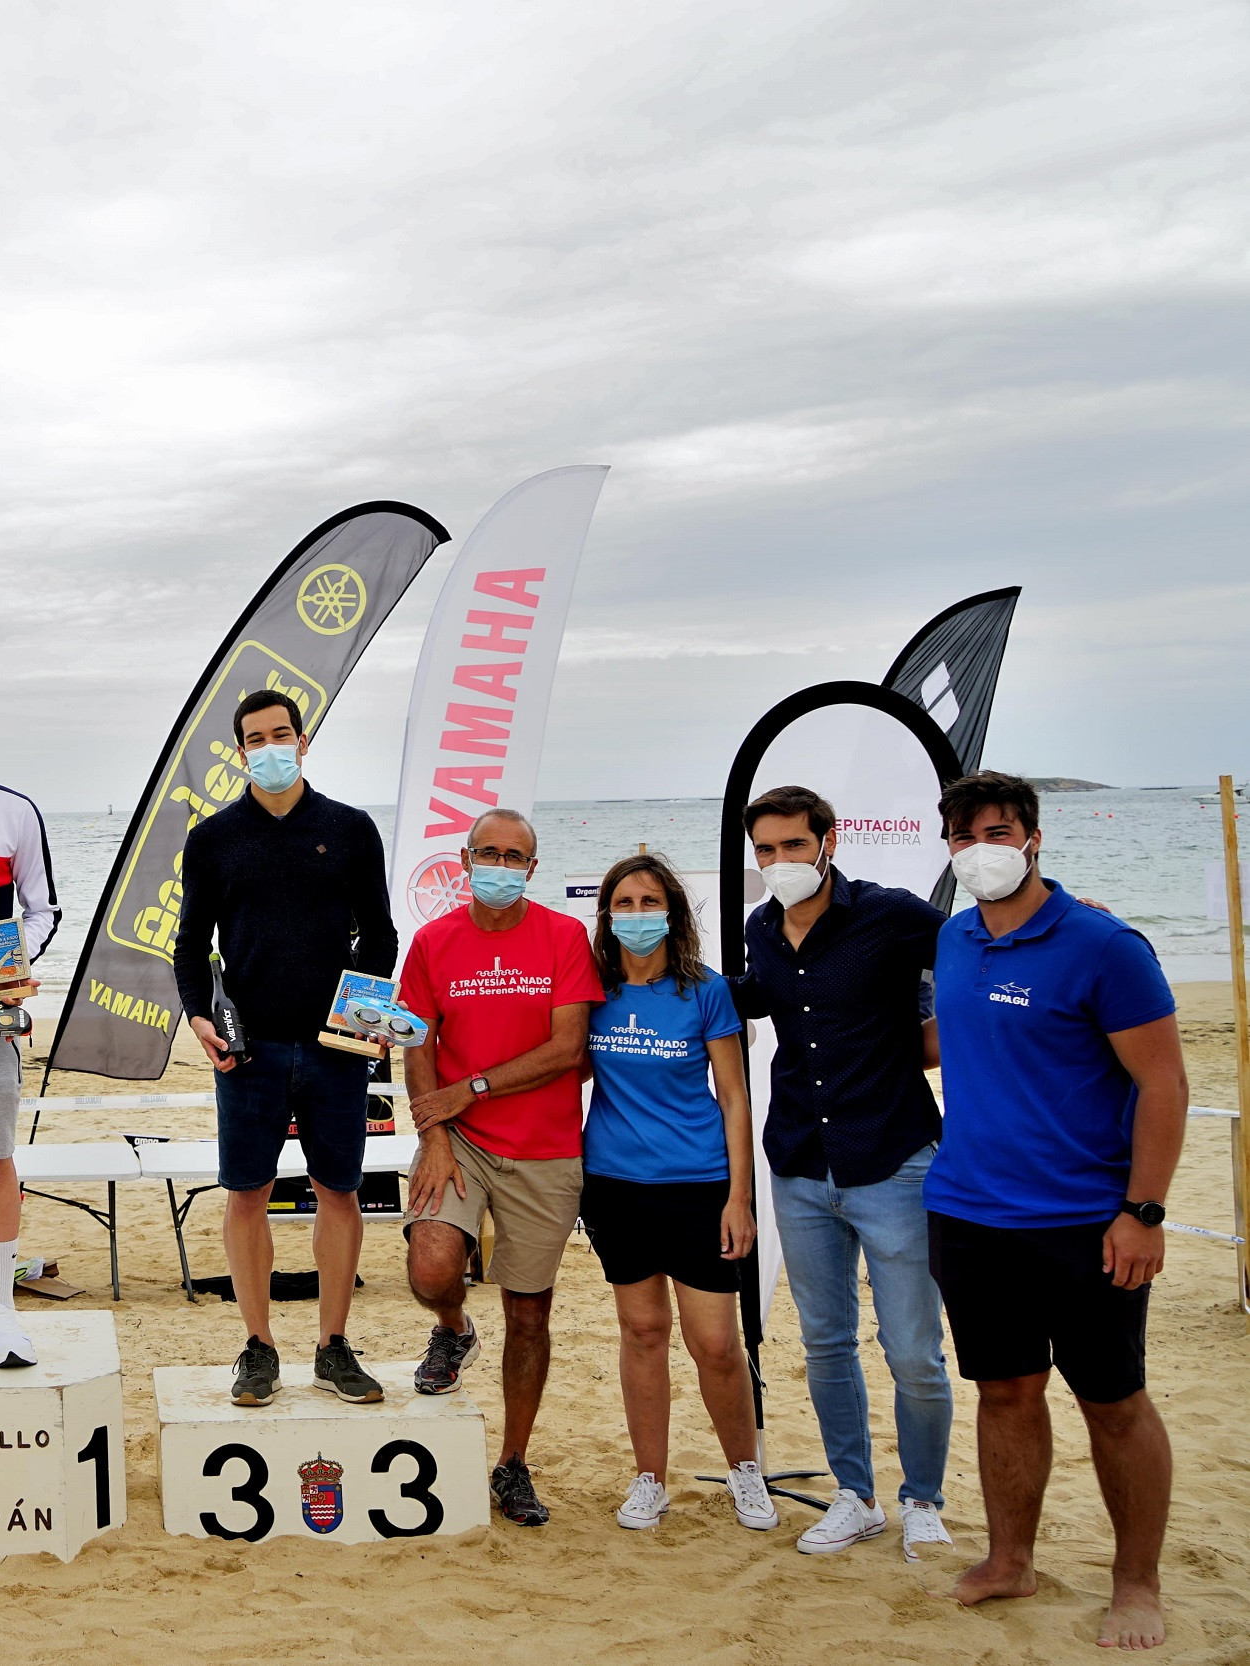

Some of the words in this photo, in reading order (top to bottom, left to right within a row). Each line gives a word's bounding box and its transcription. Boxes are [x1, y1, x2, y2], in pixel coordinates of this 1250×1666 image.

[424, 567, 547, 839] YAMAHA
[834, 816, 921, 832] EPUTACIÓN
[835, 832, 921, 846] ONTEVEDRA
[449, 980, 457, 989] X
[458, 975, 507, 988] TRAVESÍA
[509, 976, 517, 985] A
[519, 976, 552, 985] NADO
[449, 988, 476, 998] Costa
[88, 978, 172, 1034] YAMAHA
[593, 1035, 641, 1046] TRAVESÍA
[643, 1038, 652, 1047] A
[654, 1039, 688, 1049] NADO
[588, 1043, 608, 1052] osta
[610, 1044, 648, 1055] Serena
[650, 1047, 688, 1059] Nigrán
[77, 1425, 111, 1529] 1
[199, 1442, 275, 1542] 3
[367, 1439, 445, 1539] 3
